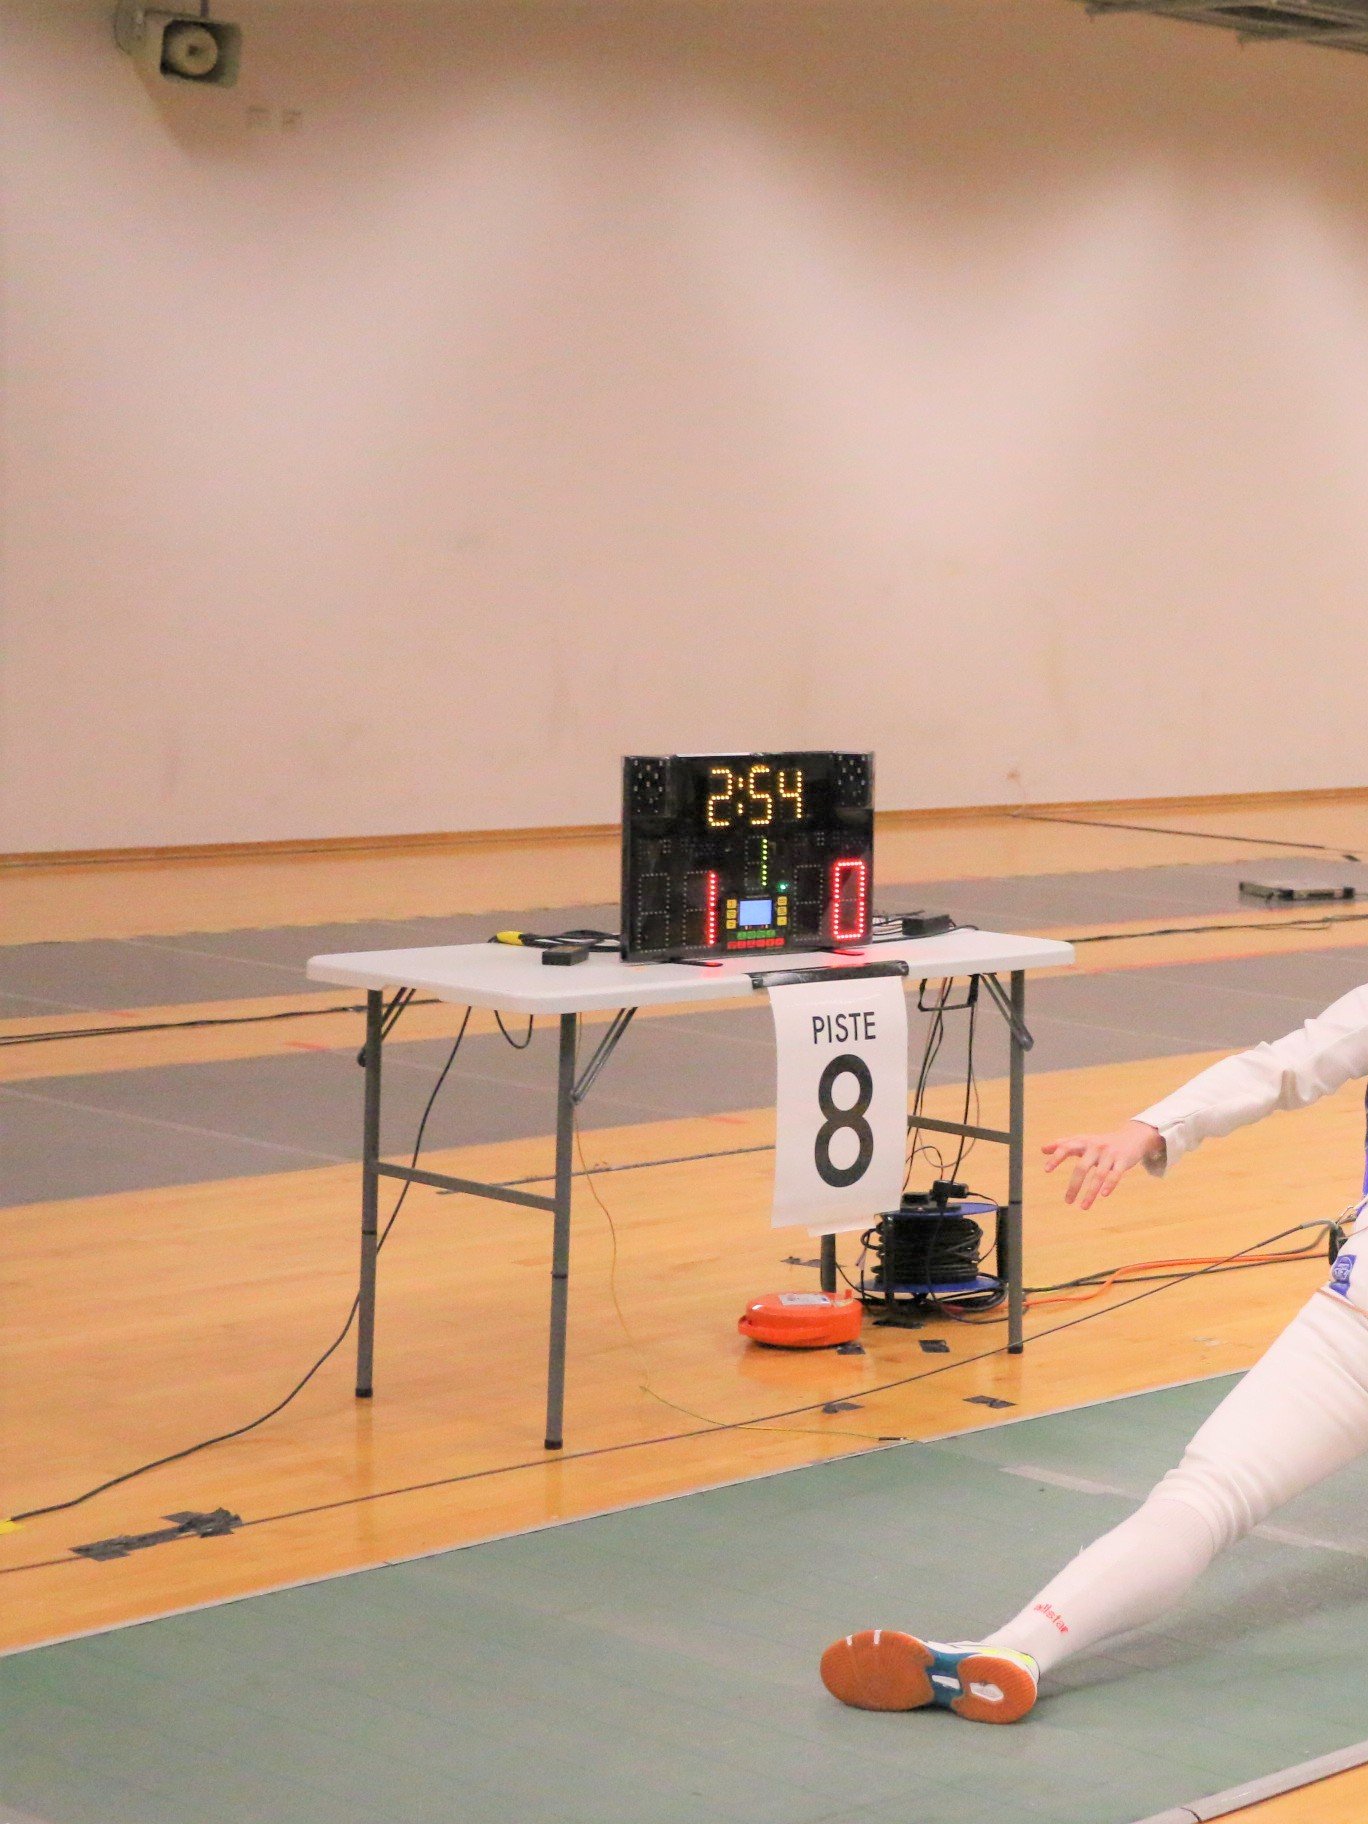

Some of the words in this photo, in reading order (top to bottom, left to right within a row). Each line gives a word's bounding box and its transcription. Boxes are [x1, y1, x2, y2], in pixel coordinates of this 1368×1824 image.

[707, 766, 803, 828] 2:54
[832, 858, 867, 942] 0
[812, 1011, 876, 1044] PISTE
[814, 1053, 874, 1188] 8
